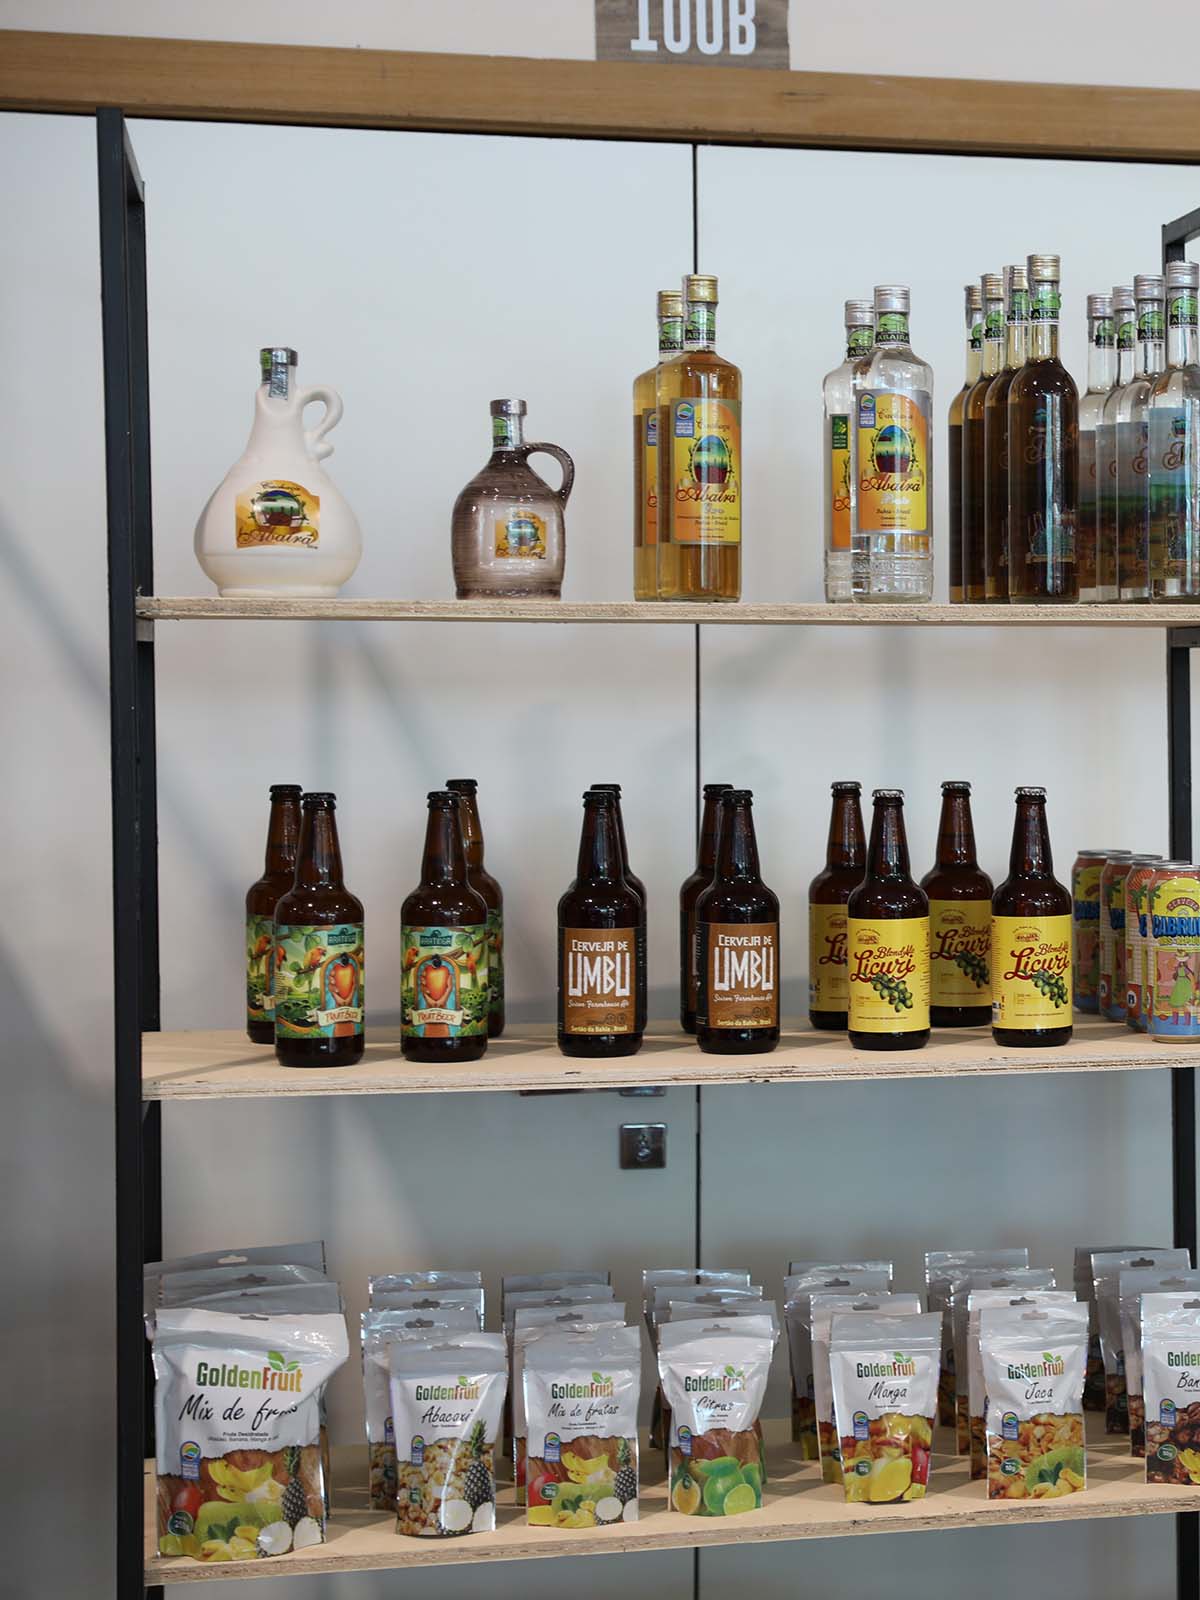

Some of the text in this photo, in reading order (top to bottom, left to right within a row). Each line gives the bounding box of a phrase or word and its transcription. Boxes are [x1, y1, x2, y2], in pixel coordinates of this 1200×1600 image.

[572, 940, 629, 952] CERVEJA DE
[718, 935, 773, 947] CERVEJA DE
[568, 951, 630, 997] UMBU
[714, 946, 774, 992] UMBU
[849, 949, 916, 983] Licuri
[1003, 947, 1070, 981] Licuri
[196, 1361, 304, 1392] GoldenFruit
[856, 1360, 916, 1379] GoldenFruit
[1007, 1359, 1065, 1380] GoldenFruit
[415, 1381, 480, 1401] GoldenFruit
[551, 1381, 614, 1400] GoldenFruit
[868, 1380, 908, 1404] Manga
[1024, 1381, 1054, 1400] Jaca
[178, 1393, 214, 1421] Mix
[222, 1396, 246, 1421] de
[421, 1405, 474, 1424] Abacaxi
[547, 1402, 620, 1422] Mix de frutas
